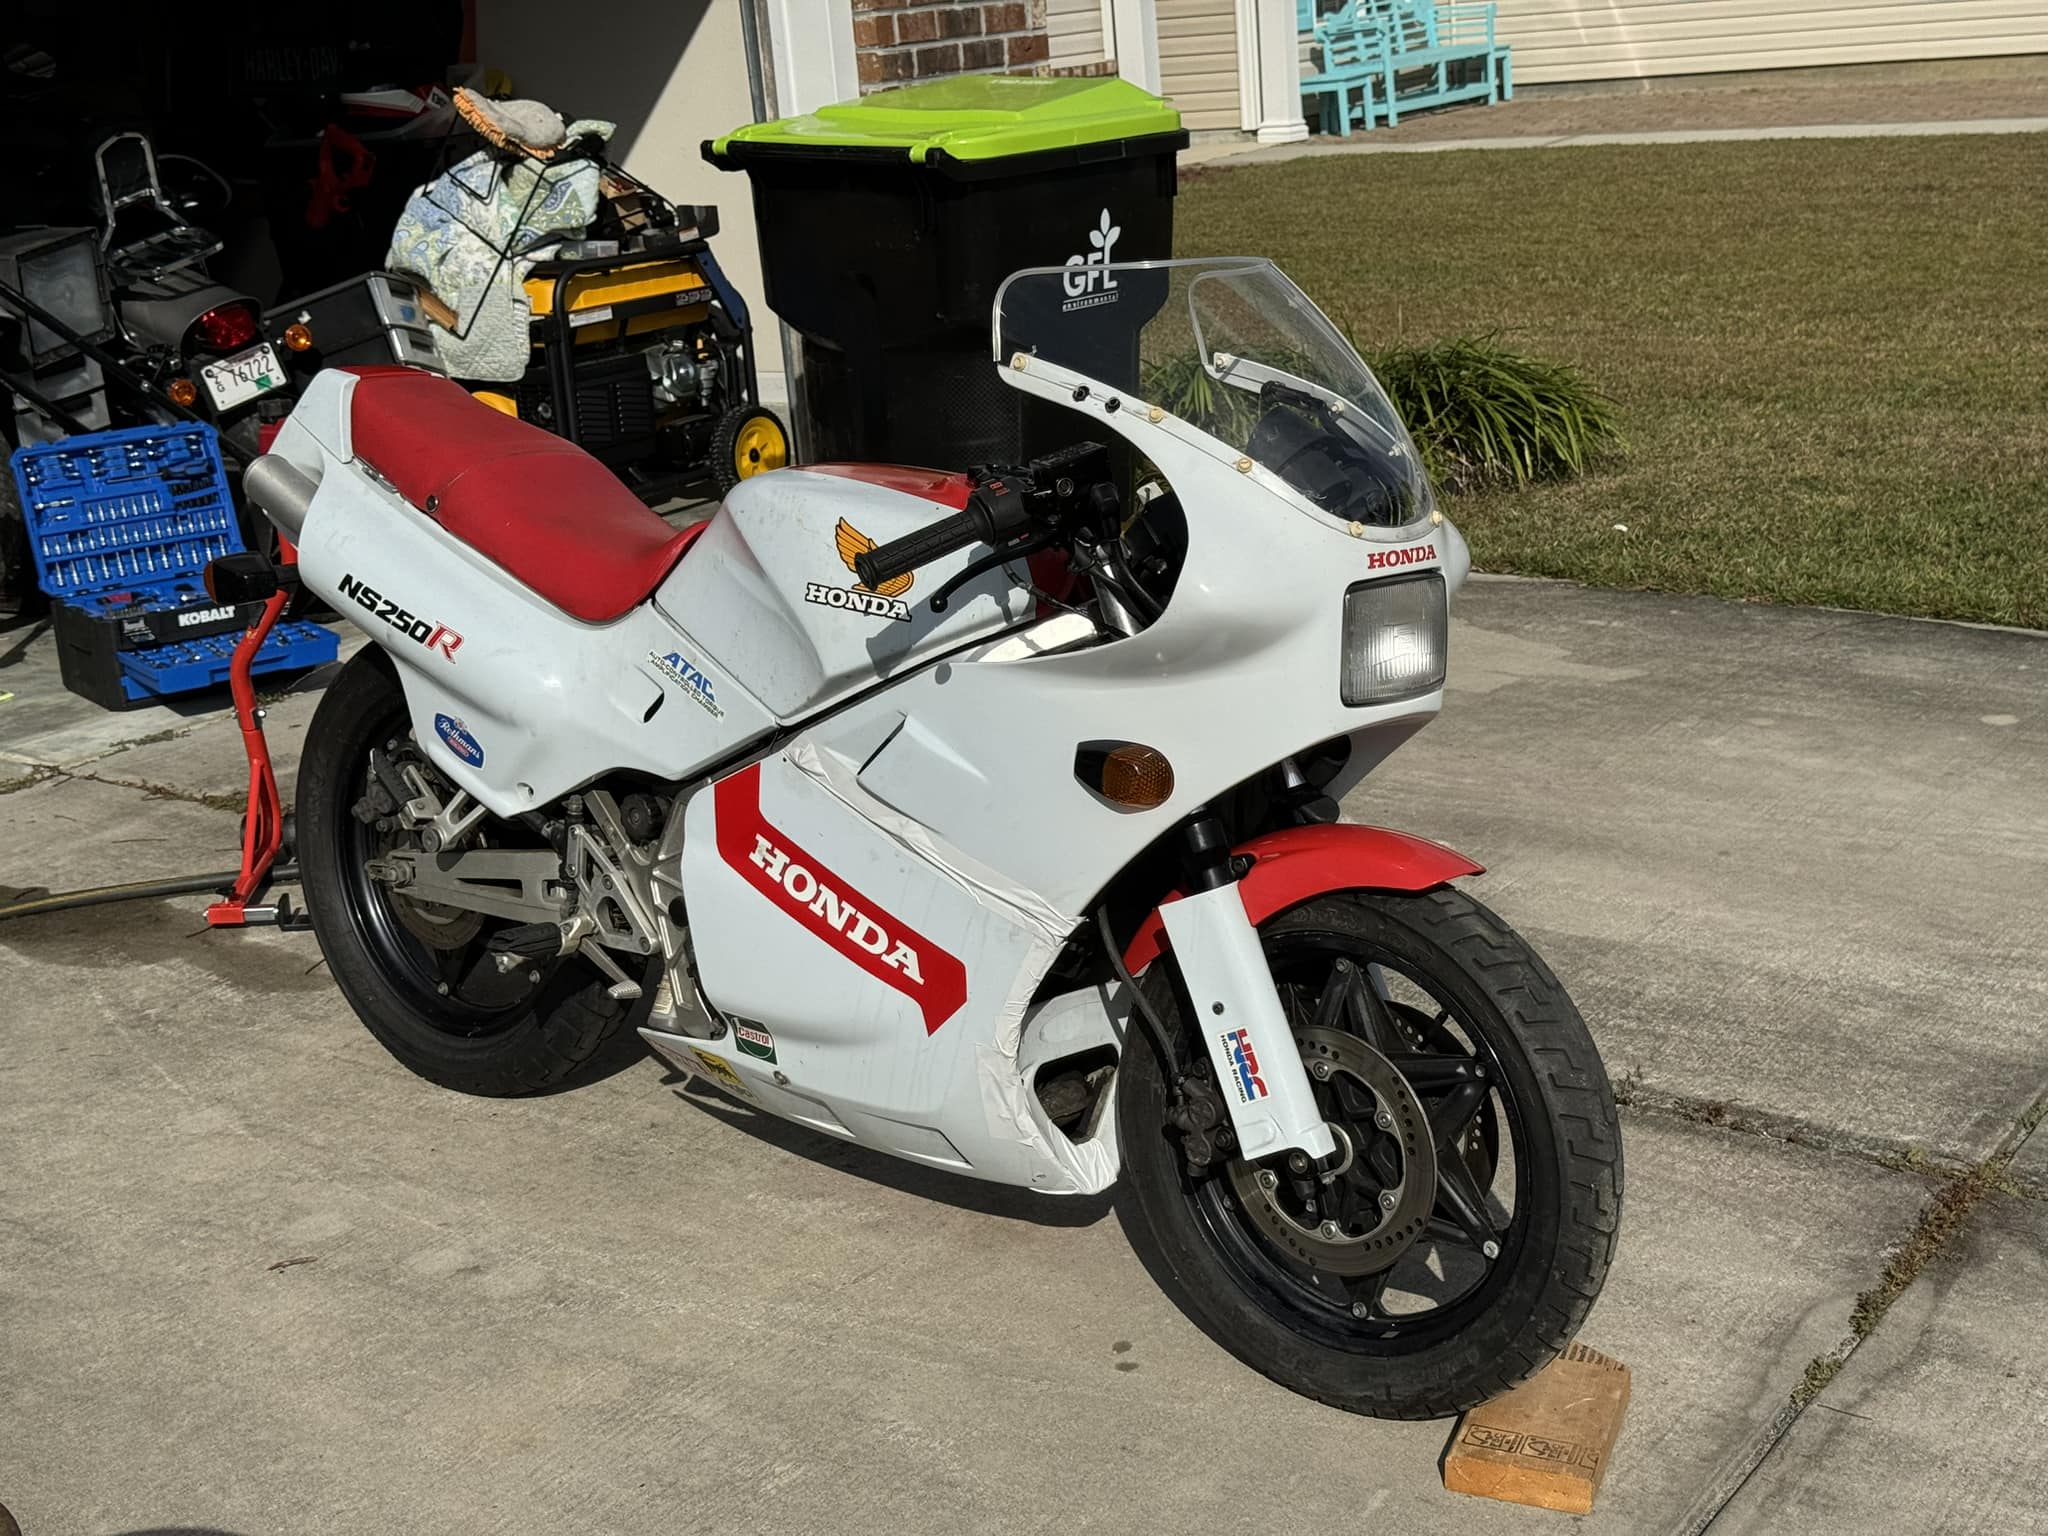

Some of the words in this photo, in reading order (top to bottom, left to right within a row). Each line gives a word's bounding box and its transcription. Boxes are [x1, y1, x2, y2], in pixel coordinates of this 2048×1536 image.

[243, 47, 343, 80] HARLEY-DAV
[1063, 245, 1119, 297] GFL
[1367, 544, 1437, 569] HONDA
[177, 605, 236, 627] KOBALT
[337, 573, 465, 664] NS250R
[804, 582, 912, 622] HONDA
[662, 652, 715, 702] ATAC
[439, 718, 480, 759] Rothmans
[749, 833, 925, 985] HONDA
[738, 1027, 770, 1045] Castrol
[1220, 1034, 1235, 1067] HONDA
[1231, 1068, 1248, 1104] RACING
[1227, 1028, 1268, 1101] HRC
